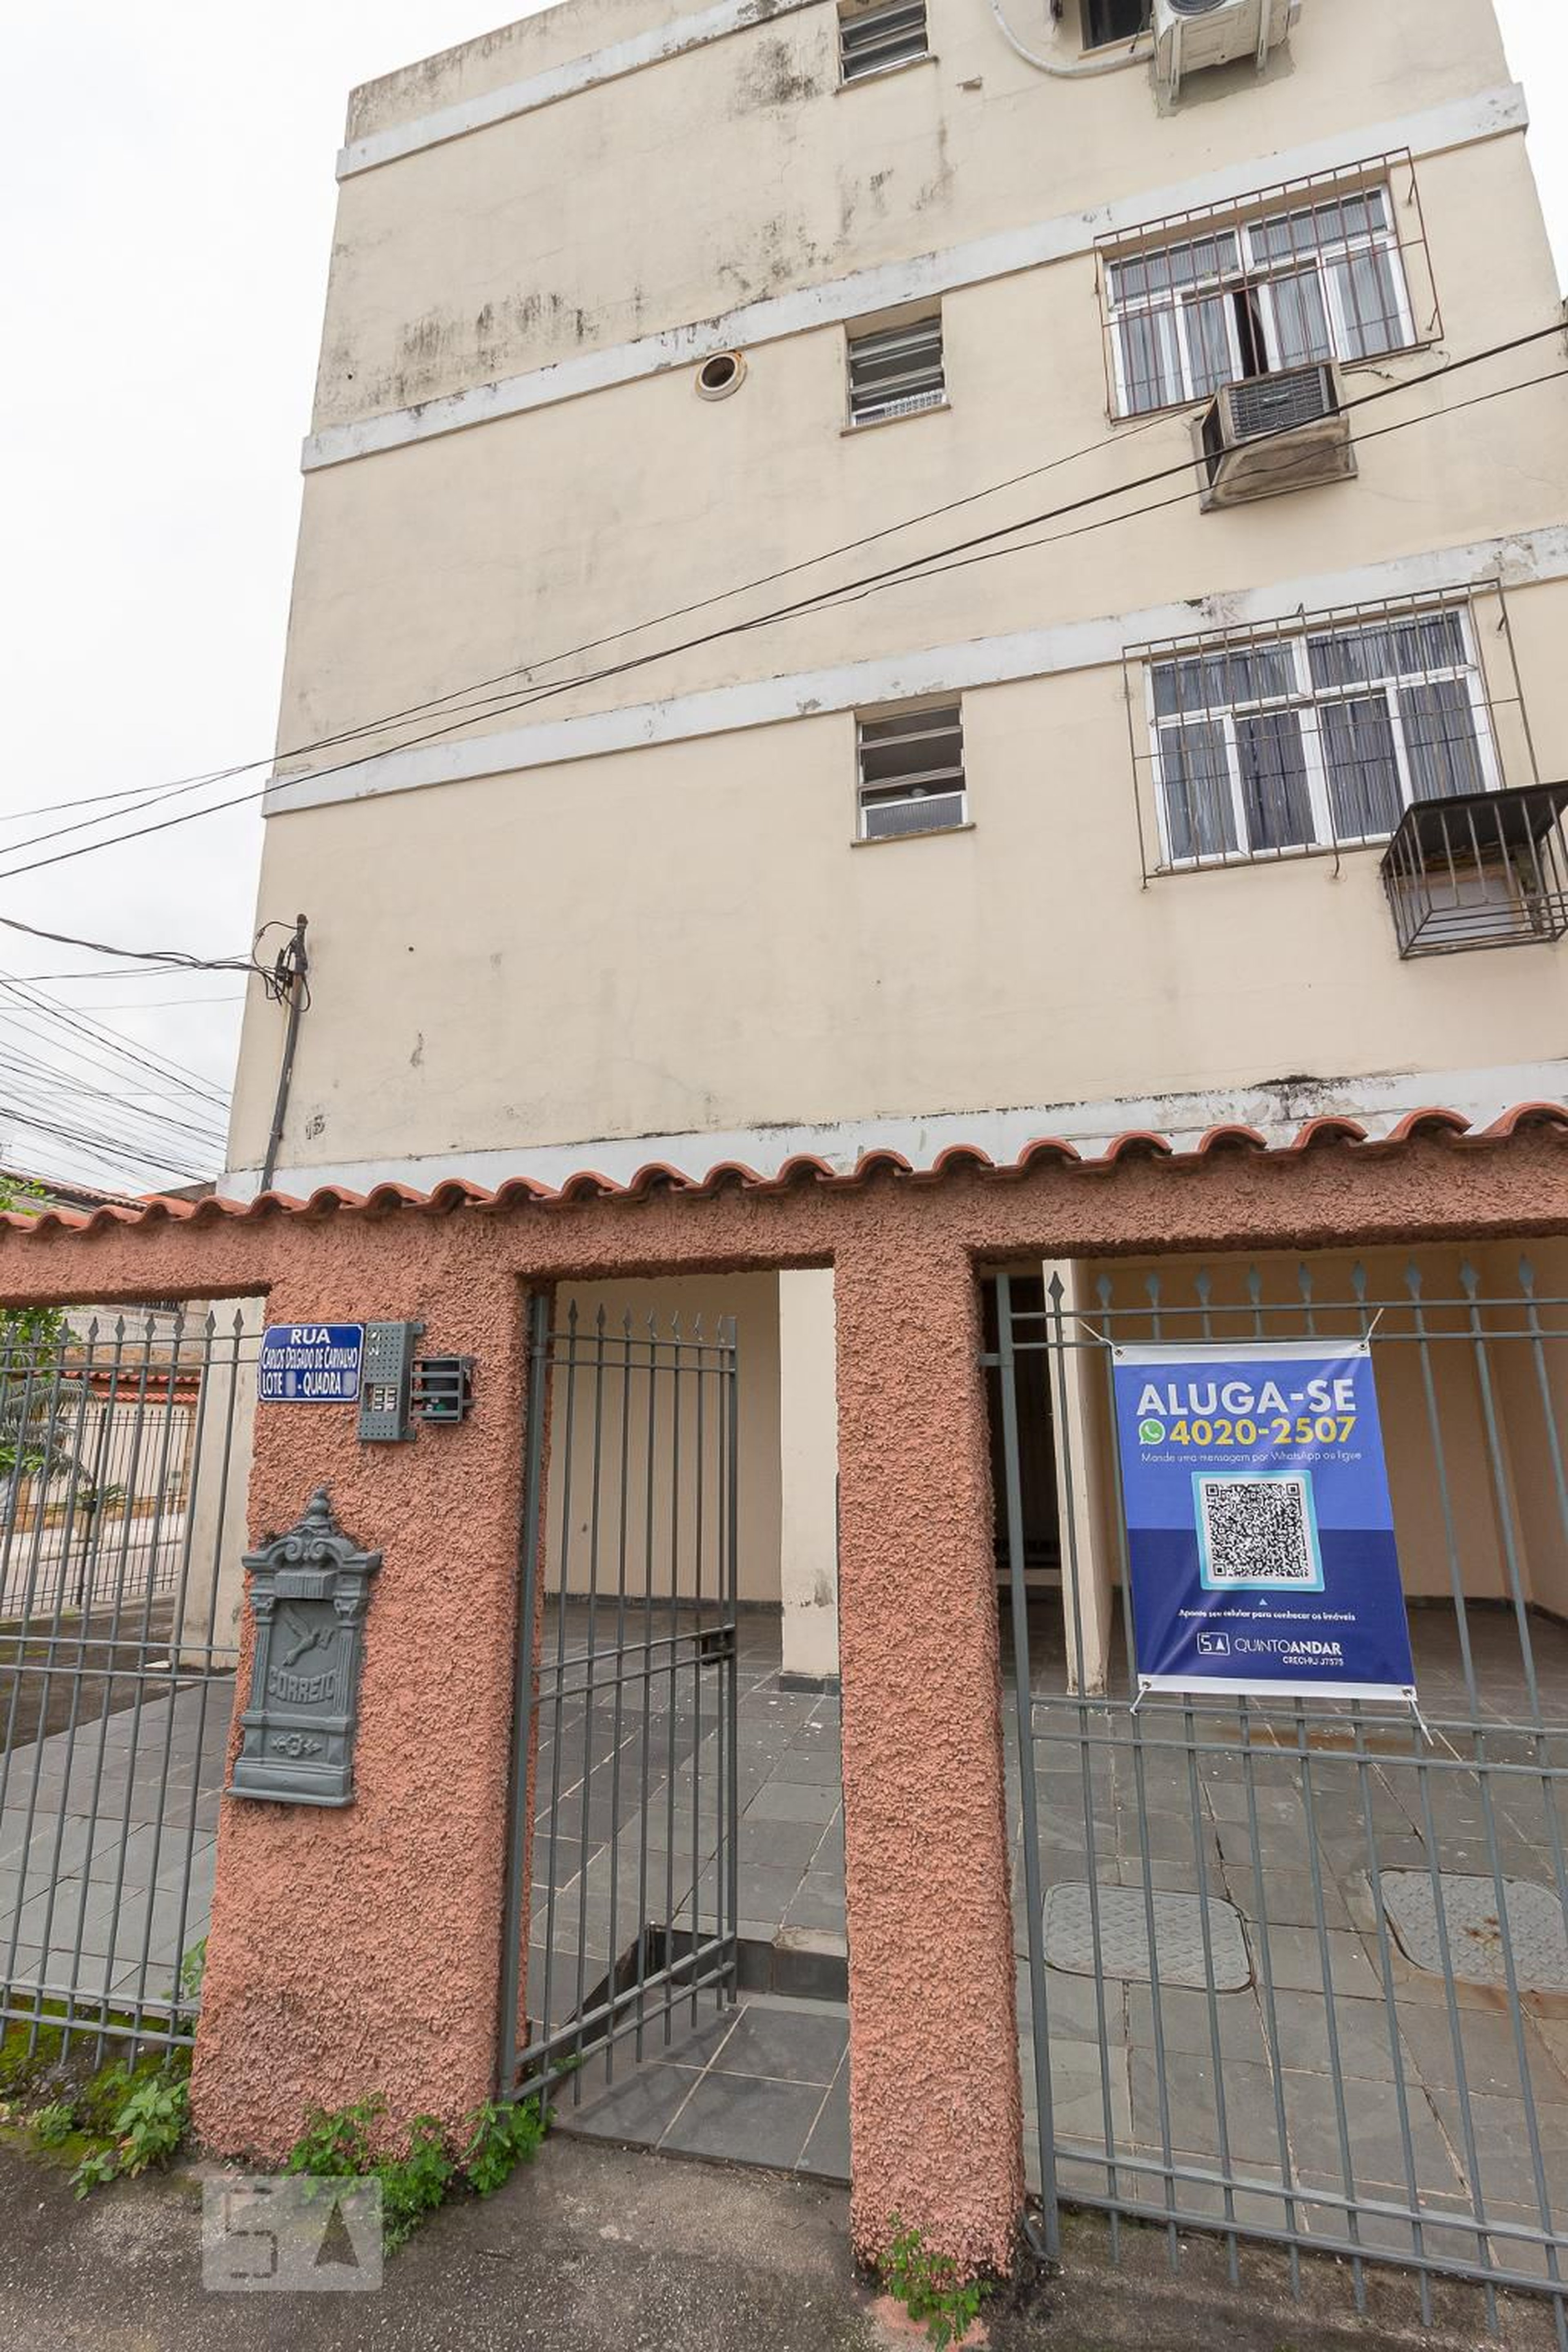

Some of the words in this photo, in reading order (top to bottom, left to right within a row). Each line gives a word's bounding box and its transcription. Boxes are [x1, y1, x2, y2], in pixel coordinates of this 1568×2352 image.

[290, 1328, 331, 1345] RUA
[263, 1372, 283, 1394] LOTE
[303, 1372, 341, 1396] QUADRA
[1136, 1379, 1356, 1416] ALUGA-SE
[1169, 1416, 1357, 1446] 4020-2507
[1142, 1451, 1175, 1462] Mande
[1177, 1454, 1197, 1462] uma
[1200, 1453, 1250, 1465] mensagem
[1252, 1454, 1268, 1462] por
[1270, 1451, 1321, 1462] WhatsApp
[1337, 1450, 1362, 1463] ligue
[1223, 1608, 1250, 1618] celular
[1252, 1612, 1272, 1620] para
[1273, 1610, 1310, 1619] conhecer
[1234, 1637, 1342, 1655] QUINTOANDAR
[268, 1666, 337, 1704] CORREIO
